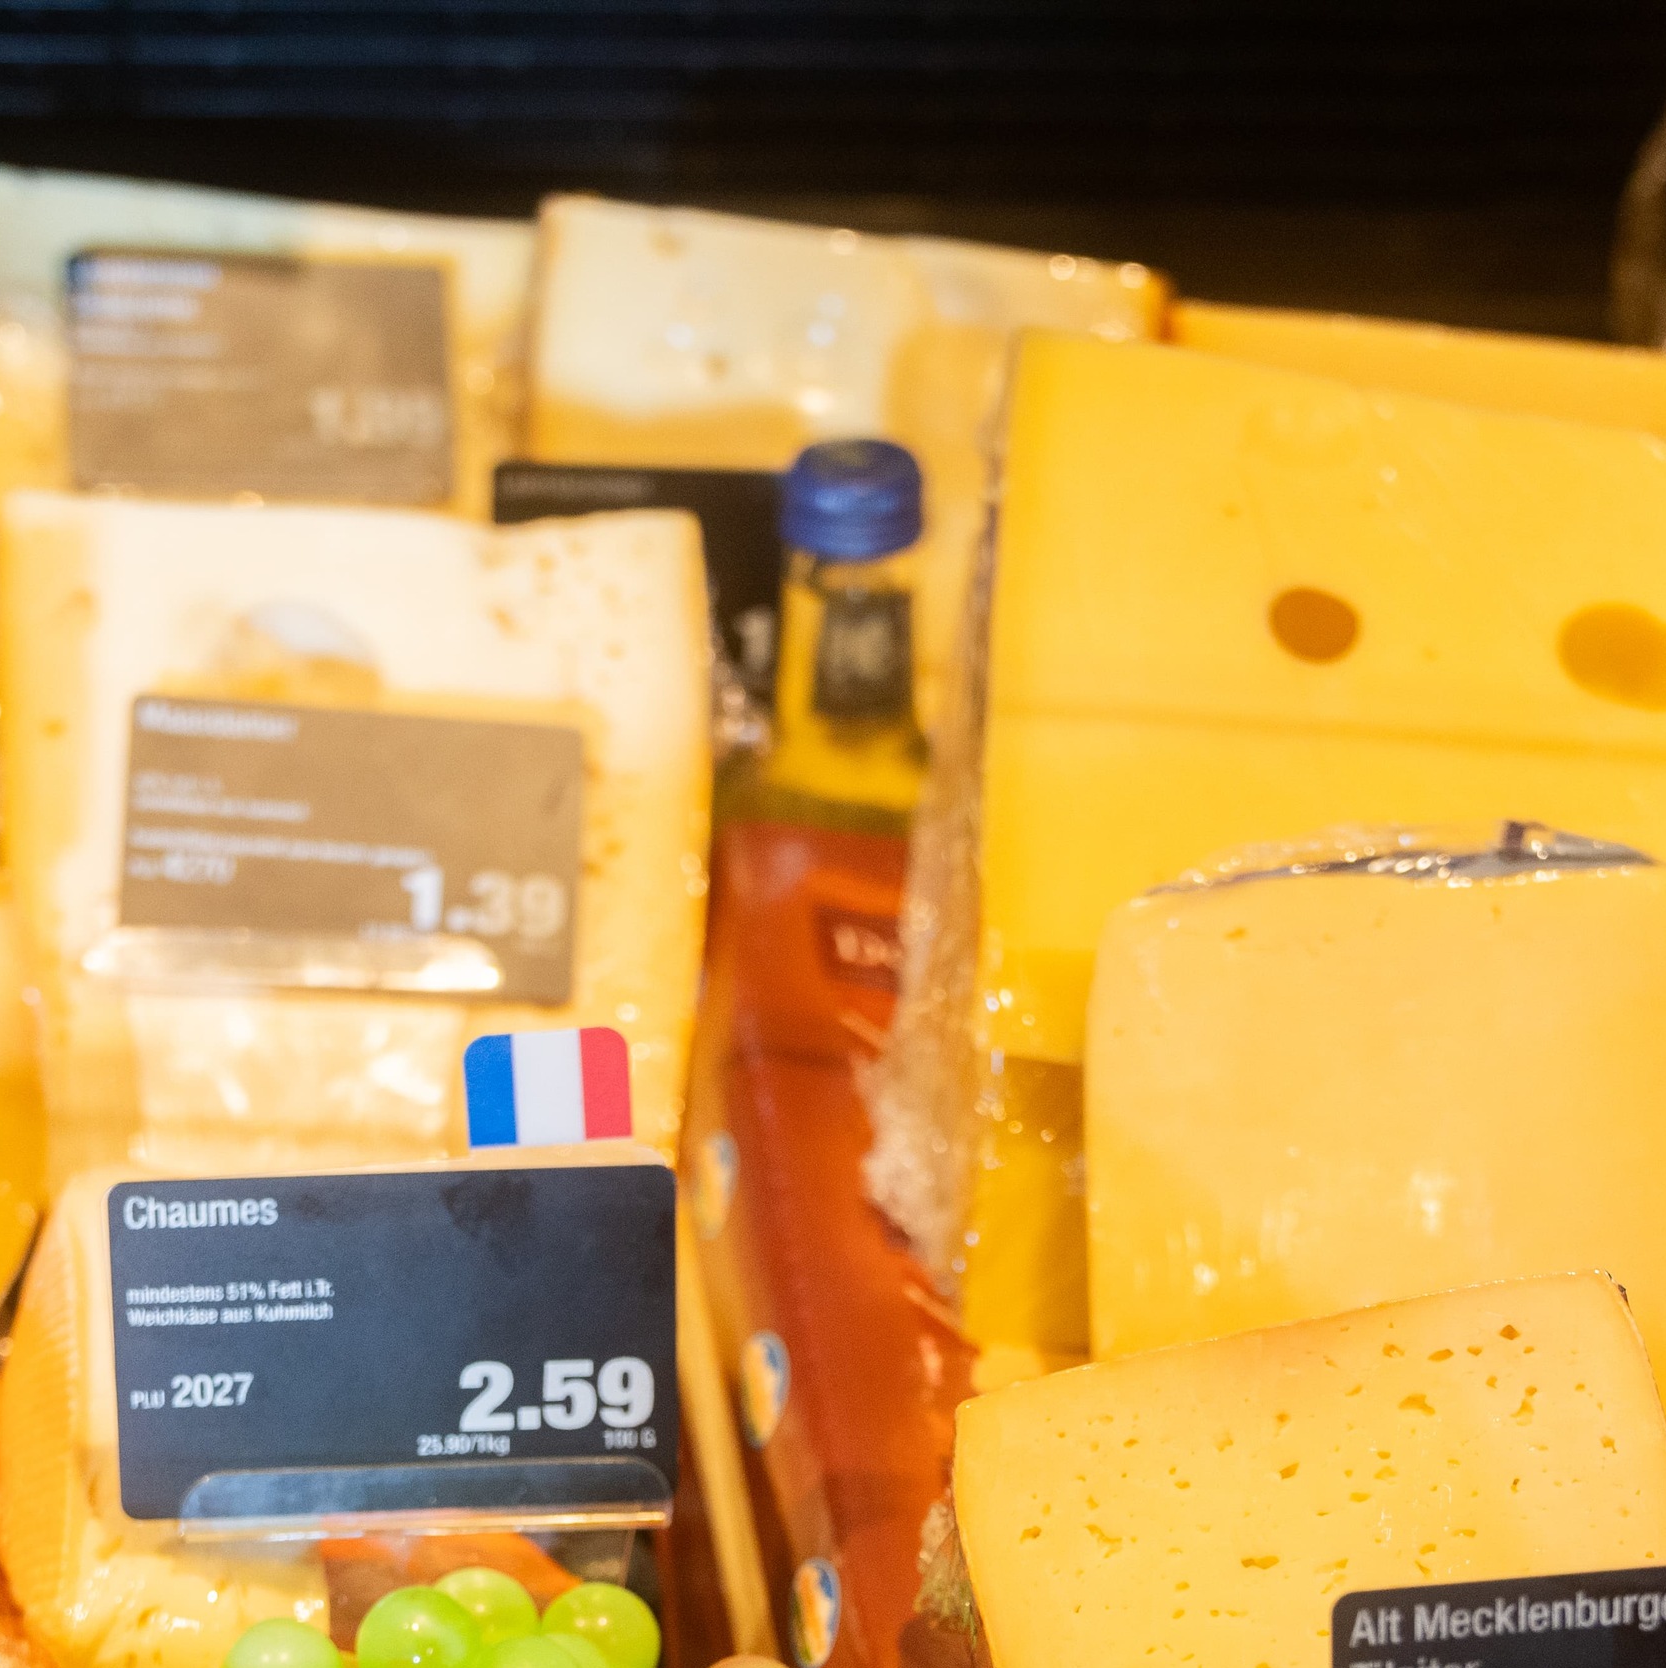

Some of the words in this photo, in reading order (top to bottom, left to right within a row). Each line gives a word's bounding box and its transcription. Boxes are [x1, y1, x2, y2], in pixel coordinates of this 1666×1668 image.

[400, 864, 567, 938] 1.39
[123, 1195, 278, 1229] Chaumes
[127, 1283, 223, 1305] mindestens
[268, 1279, 302, 1300] Fett
[127, 1305, 217, 1327] Weichkäse
[220, 1304, 252, 1324] aus
[254, 1301, 334, 1323] Kuhmilch
[130, 1389, 165, 1409] PLU
[171, 1373, 254, 1408] 2027
[459, 1356, 655, 1432] 2.59
[416, 1431, 511, 1457] 25.90/1kg
[603, 1430, 637, 1450] 100
[640, 1429, 657, 1449] G
[1349, 1608, 1403, 1648] Alt
